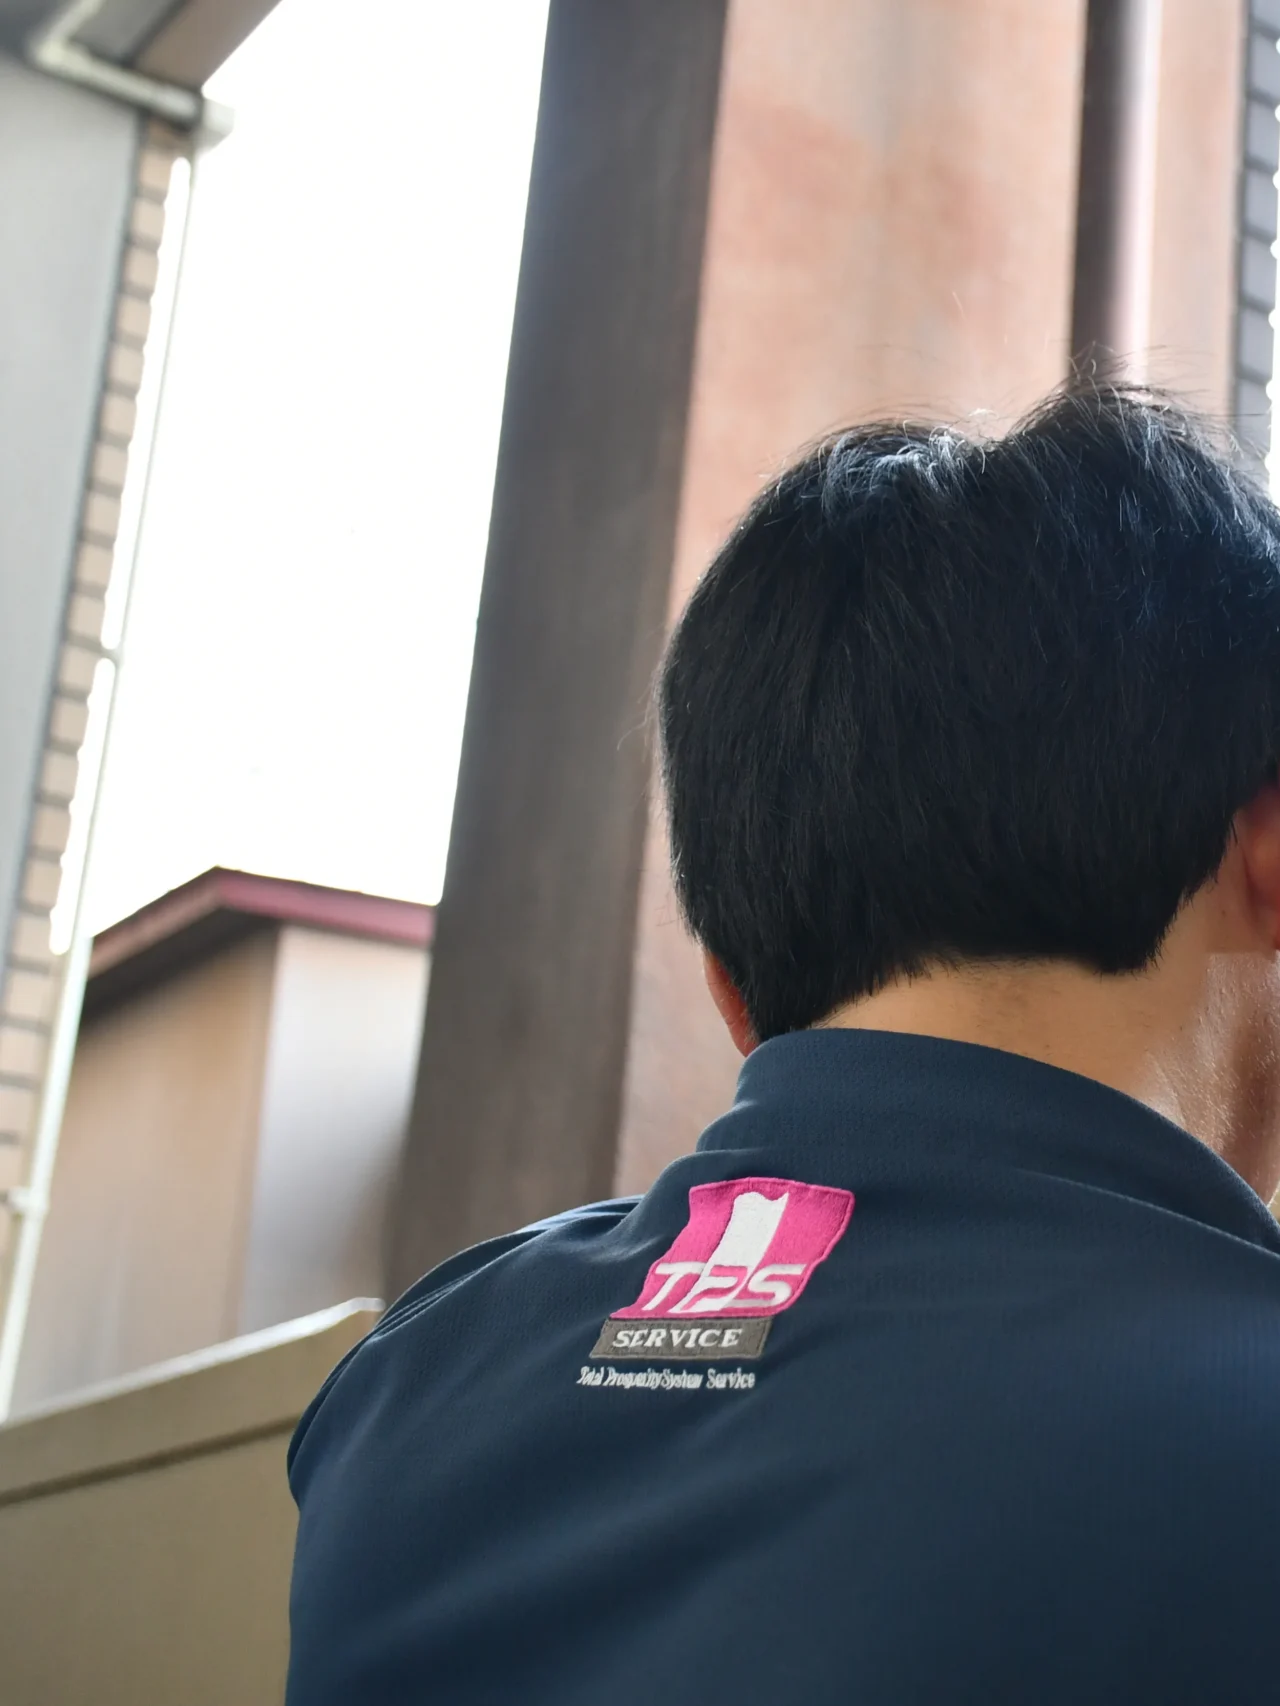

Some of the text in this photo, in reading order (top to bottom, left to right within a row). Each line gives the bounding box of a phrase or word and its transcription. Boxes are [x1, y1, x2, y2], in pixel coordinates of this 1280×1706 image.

[642, 1261, 807, 1314] TPS
[612, 1328, 743, 1349] SERVICE
[706, 1367, 756, 1390] Service
